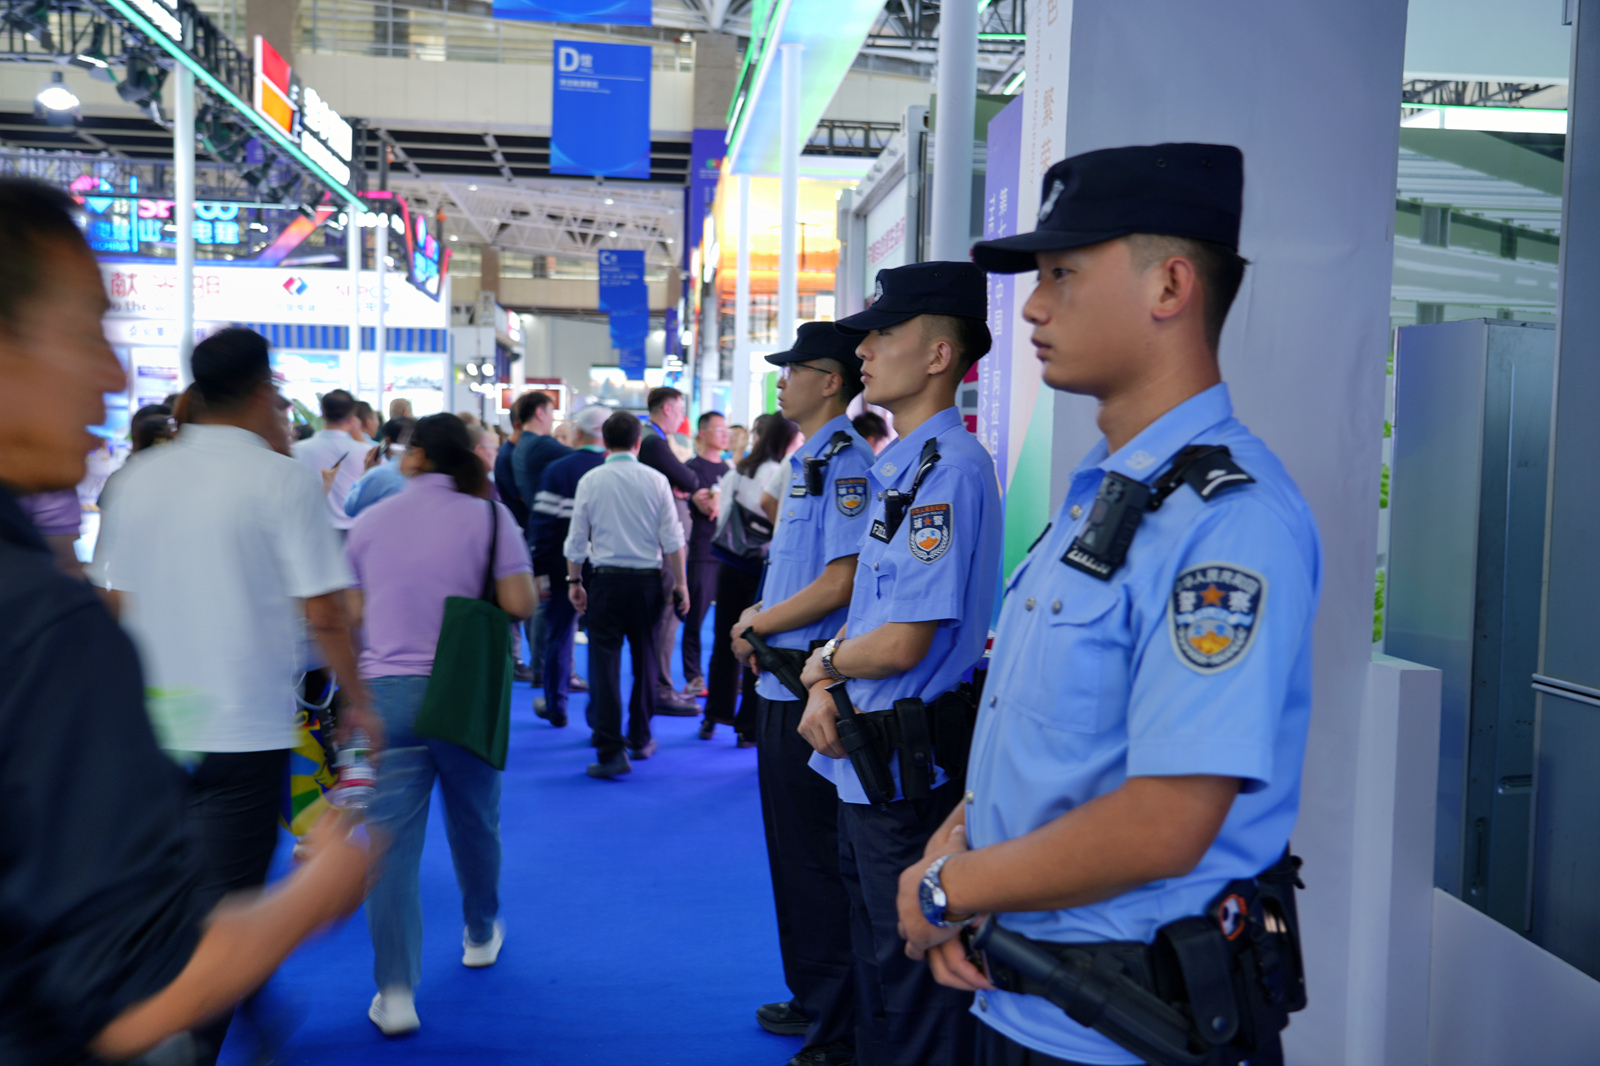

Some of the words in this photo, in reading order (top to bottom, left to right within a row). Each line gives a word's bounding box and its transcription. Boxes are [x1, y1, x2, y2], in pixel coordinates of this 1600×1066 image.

[138, 197, 240, 220] SECO
[988, 193, 996, 235] THE
[138, 218, 240, 245] 山电建
